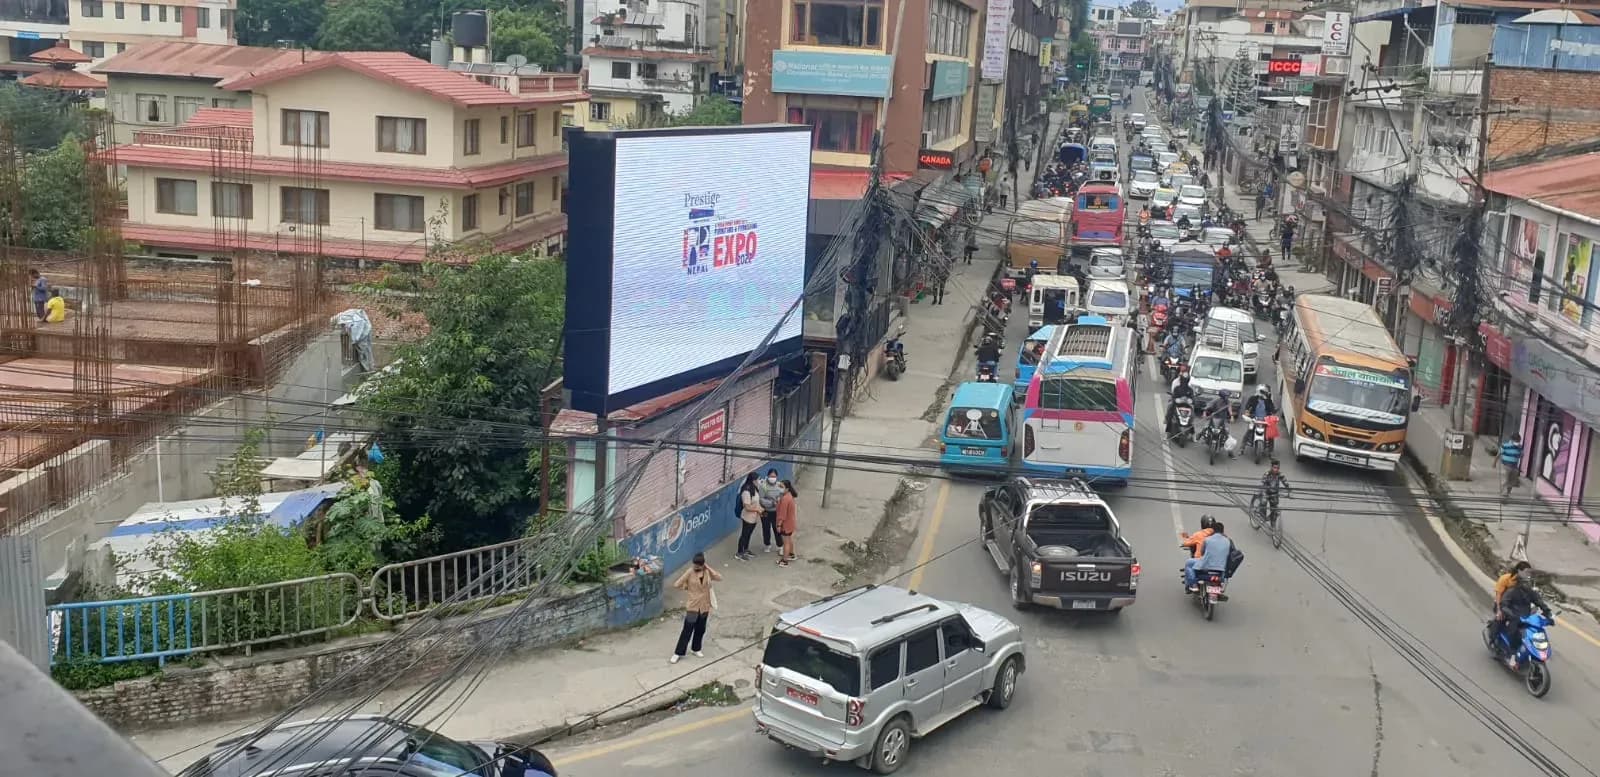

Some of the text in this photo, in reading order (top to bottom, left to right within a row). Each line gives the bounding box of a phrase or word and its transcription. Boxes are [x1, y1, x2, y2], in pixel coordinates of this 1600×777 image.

[920, 155, 953, 166] CANADA
[684, 191, 720, 207] Prestige
[713, 231, 757, 268] EXPO
[687, 265, 709, 275] NEPAL
[685, 506, 711, 536] pepsi
[1060, 571, 1111, 582] ISUZU
